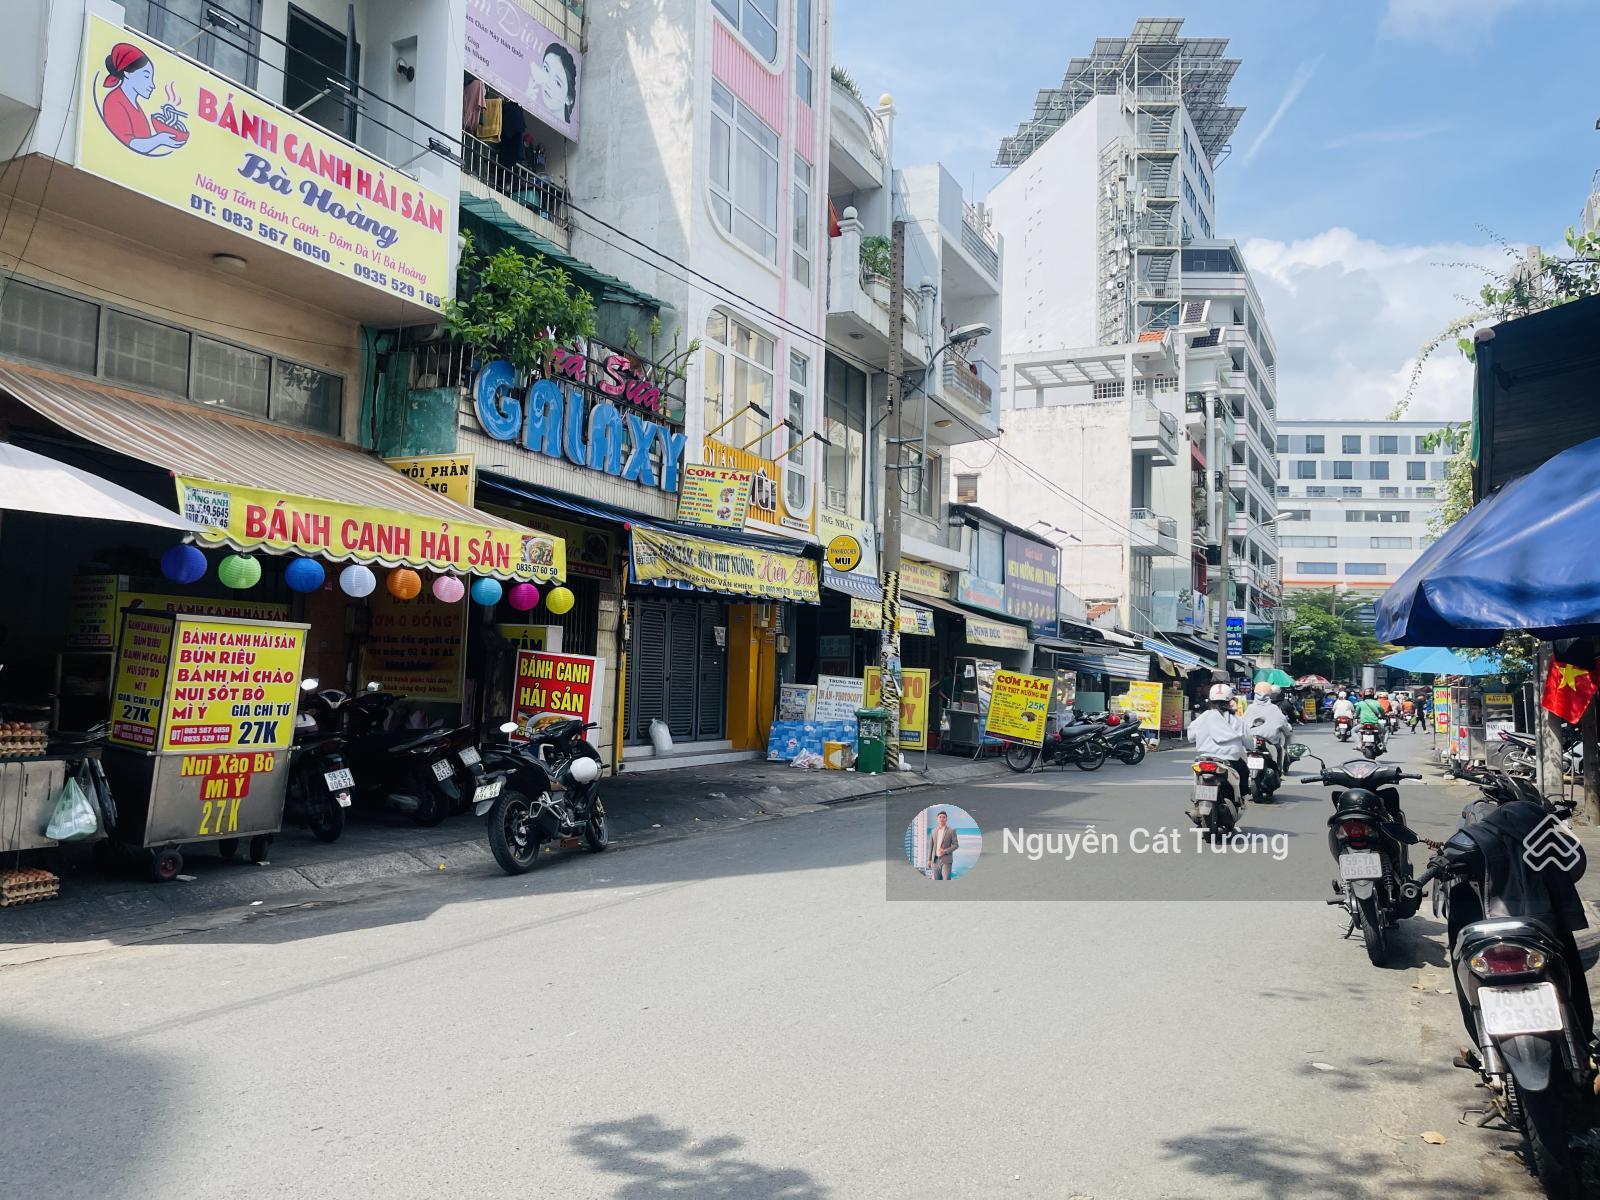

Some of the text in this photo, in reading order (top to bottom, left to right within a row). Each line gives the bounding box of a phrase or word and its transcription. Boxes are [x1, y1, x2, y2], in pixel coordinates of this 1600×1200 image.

[198, 87, 443, 234] BÁNH CANH HẢI SẢN
[237, 153, 399, 249] Bà Hoàng
[195, 173, 229, 201] Nâng
[259, 201, 289, 225] Bánh
[292, 216, 319, 238] Canh
[355, 243, 369, 259] Đà
[372, 249, 381, 264] Vị
[383, 255, 396, 271] Bà
[397, 260, 428, 285] Hoàng
[190, 193, 217, 217] ĐT:
[222, 207, 253, 232] 083
[258, 222, 289, 246] 567
[293, 237, 331, 263] 6050
[354, 262, 387, 286] 0935
[391, 277, 416, 298] 529
[419, 289, 441, 308] 168
[474, 358, 689, 494] GALAXY
[431, 459, 470, 478] PHẦN
[686, 468, 751, 482] CƠM TẤM
[244, 500, 510, 569] BÁNH CANH HẢI SẢN
[698, 545, 714, 569] BÚN
[731, 552, 755, 577] NƯỚNG
[701, 576, 716, 585] UNG
[182, 627, 296, 650] BÁNH CANH HẢI SẢN
[180, 646, 256, 665] BÚN RIÊU
[177, 665, 295, 684] BÁNH MÌ CHẢO
[519, 655, 591, 685] BÁNH CANH
[174, 686, 206, 701] NUI
[208, 680, 239, 701] SỐT
[870, 674, 923, 699] PTO
[997, 674, 1050, 692] CƠM TẤM
[519, 682, 585, 713] HẢI SẢN
[1027, 701, 1046, 711] 25K
[122, 704, 151, 723] 27K
[172, 702, 292, 720] MÌ Ý GIÁ CHỈ TỪ
[184, 726, 198, 734] 083
[199, 726, 212, 734] 567
[213, 725, 230, 733] 6050
[202, 734, 215, 742] 529
[216, 734, 229, 742] 168
[238, 720, 279, 745] 27K
[181, 752, 274, 776] Nui Xào Bò
[205, 773, 246, 799] Mì Ý
